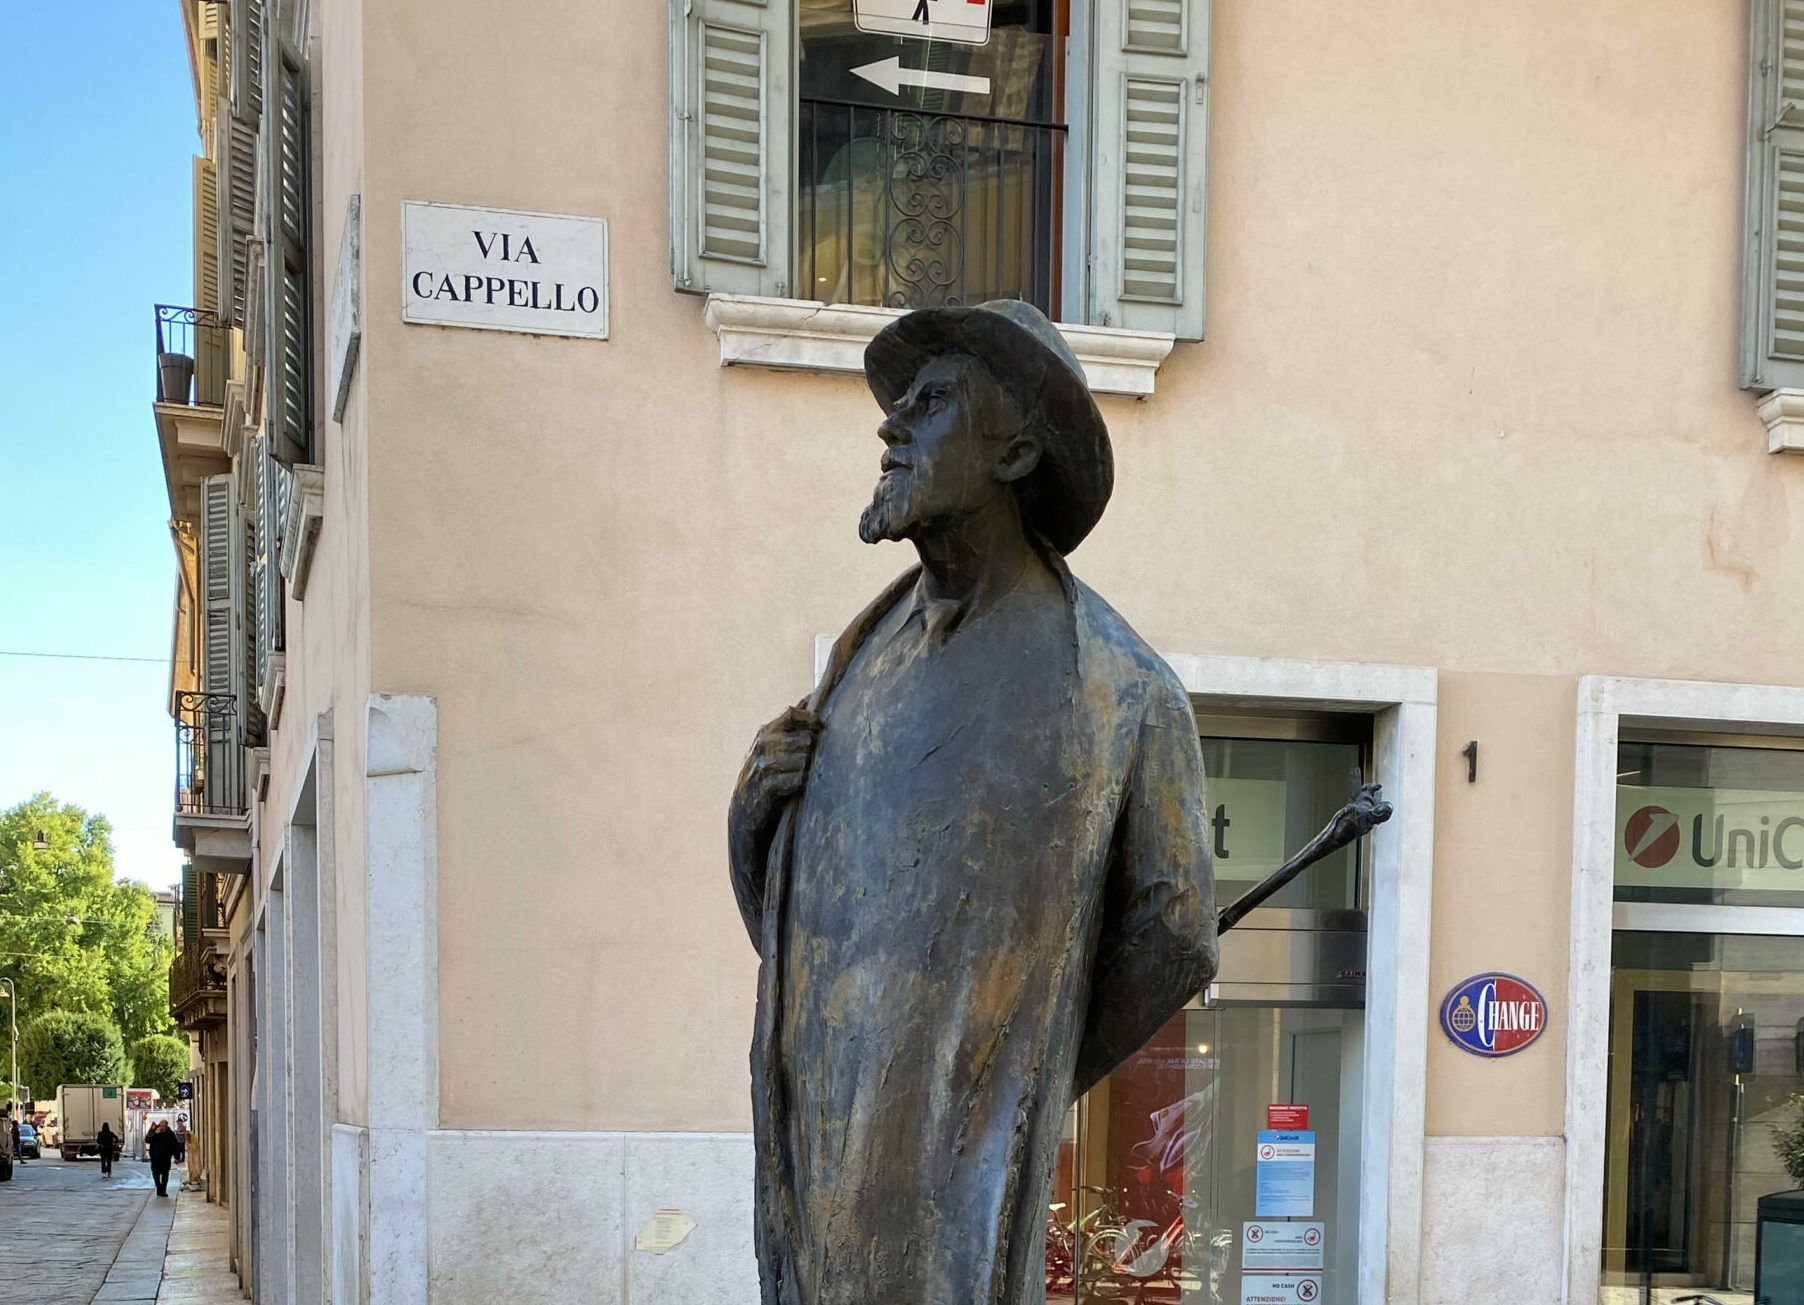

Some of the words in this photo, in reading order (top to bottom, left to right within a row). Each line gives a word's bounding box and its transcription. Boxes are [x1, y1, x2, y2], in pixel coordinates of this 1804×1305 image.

[471, 230, 541, 264] VIA
[412, 271, 599, 314] CAPPELLO
[1462, 740, 1478, 783] 1
[1477, 982, 1541, 1048] CHANGE
